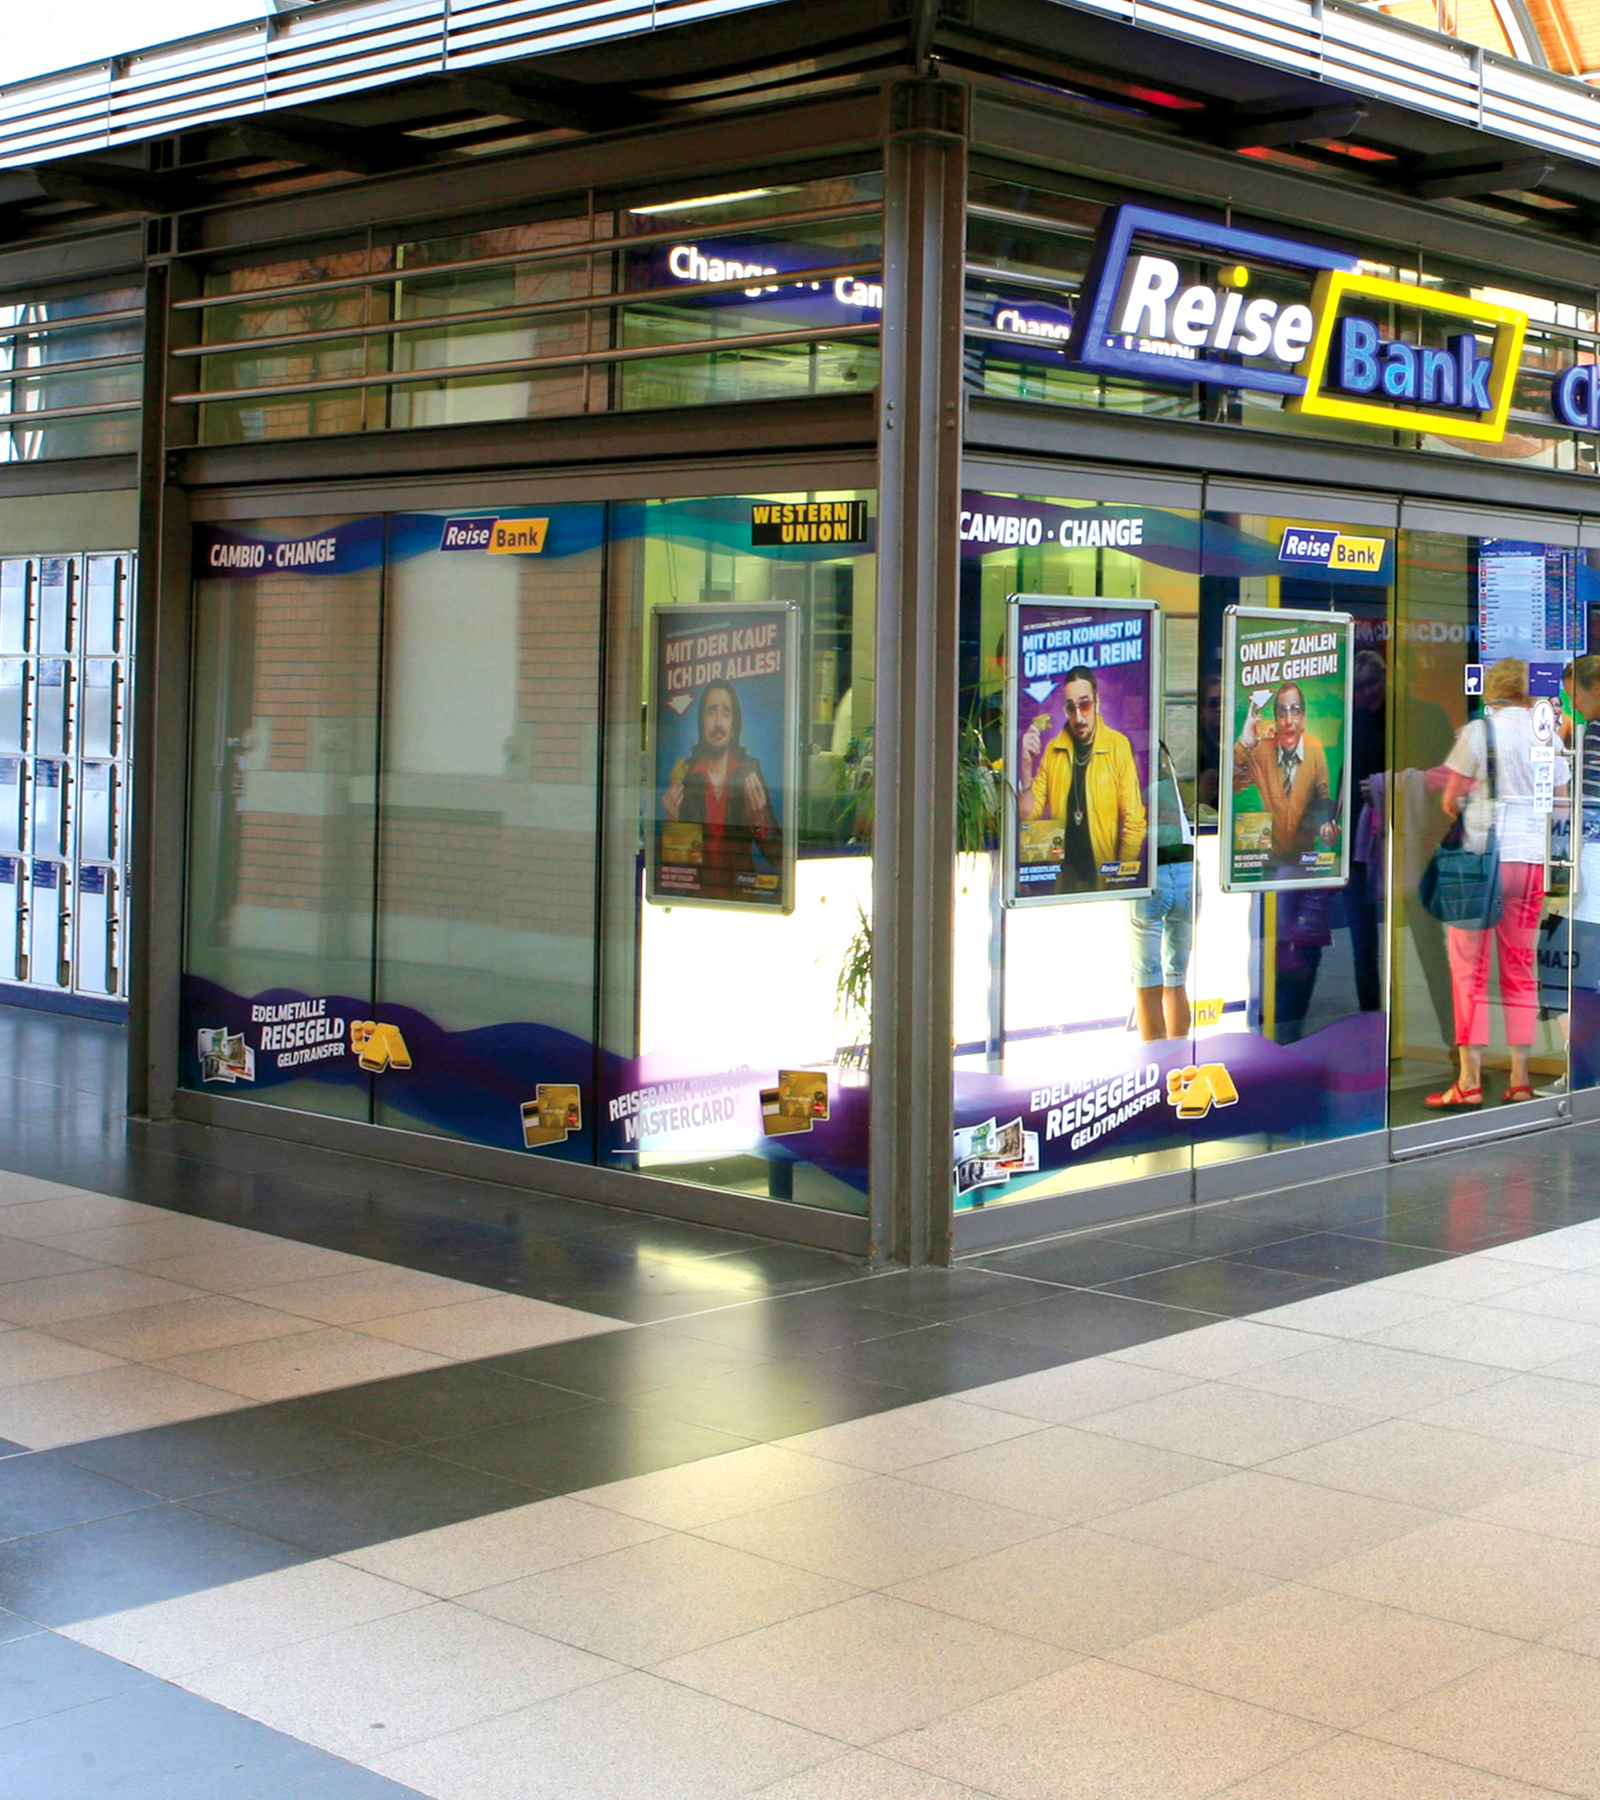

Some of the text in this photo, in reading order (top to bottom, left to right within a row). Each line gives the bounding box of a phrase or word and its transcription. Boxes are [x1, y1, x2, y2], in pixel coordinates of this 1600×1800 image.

[1120, 255, 1493, 412] Reise Bank
[753, 502, 848, 524] WESTERN
[960, 511, 1144, 548] CAMBIO CHANGE
[445, 522, 539, 548] Reise Bank
[781, 522, 848, 543] UNION
[210, 537, 336, 568] CAMBIO CHANGE
[1286, 534, 1376, 565] Reise Bank
[665, 639, 694, 664] MIT
[697, 633, 729, 659] DER
[732, 623, 778, 652] KAUF
[1022, 633, 1045, 652] MIT
[1047, 629, 1072, 649] DER
[1072, 621, 1123, 645] KOMMST
[1125, 619, 1142, 637] DU
[1240, 639, 1286, 663] ONLINE
[1290, 632, 1337, 656] ZAHLEN
[667, 649, 781, 691] ICH DIR ALLES!
[1024, 638, 1143, 678] ÜBERALL REIN!
[1241, 653, 1338, 687] GANZ GEHEIM!
[252, 999, 326, 1023] EDELMETALLE
[261, 1018, 344, 1051] REISEGELD
[277, 1042, 345, 1068] GELDTRANSFER
[1046, 1063, 1160, 1141] REISEGELD
[1070, 1089, 1161, 1151] GELDTRANSFER
